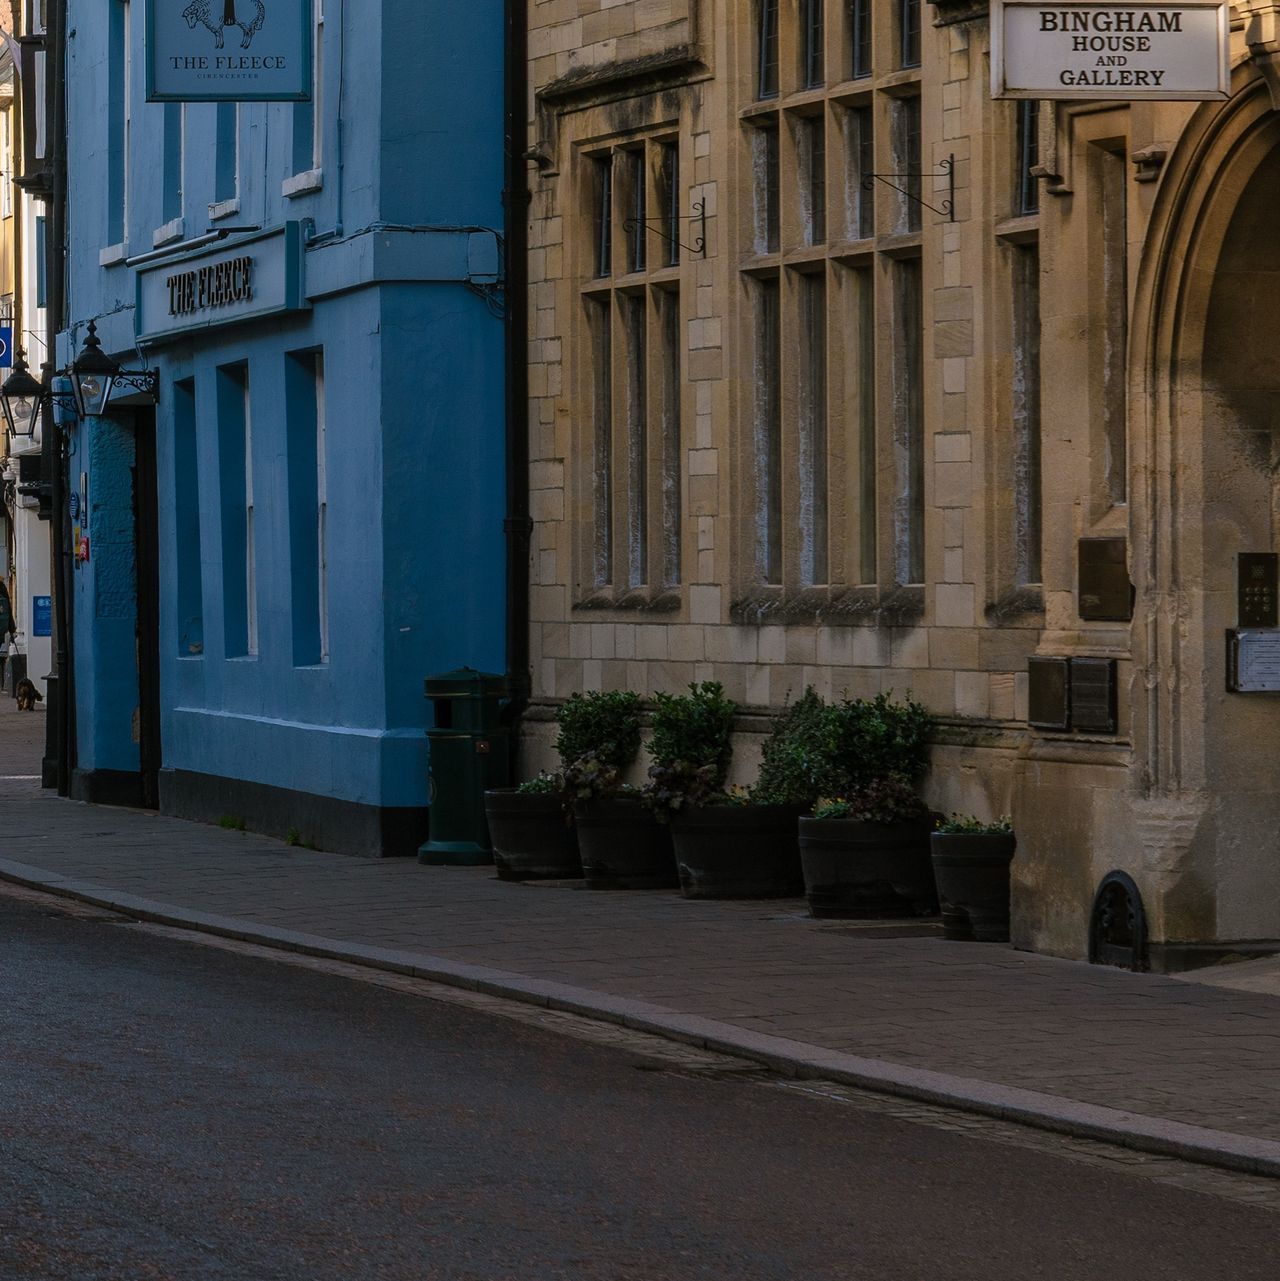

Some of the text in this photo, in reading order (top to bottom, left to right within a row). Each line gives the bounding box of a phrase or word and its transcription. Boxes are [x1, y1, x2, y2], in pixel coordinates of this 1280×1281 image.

[1039, 11, 1183, 32] BINGHAM
[1071, 36, 1151, 52] HOUSE
[170, 55, 287, 70] THE FLEECE
[1095, 55, 1128, 67] AND
[1059, 69, 1166, 86] GALLERY
[166, 255, 254, 316] THE FLEECE
